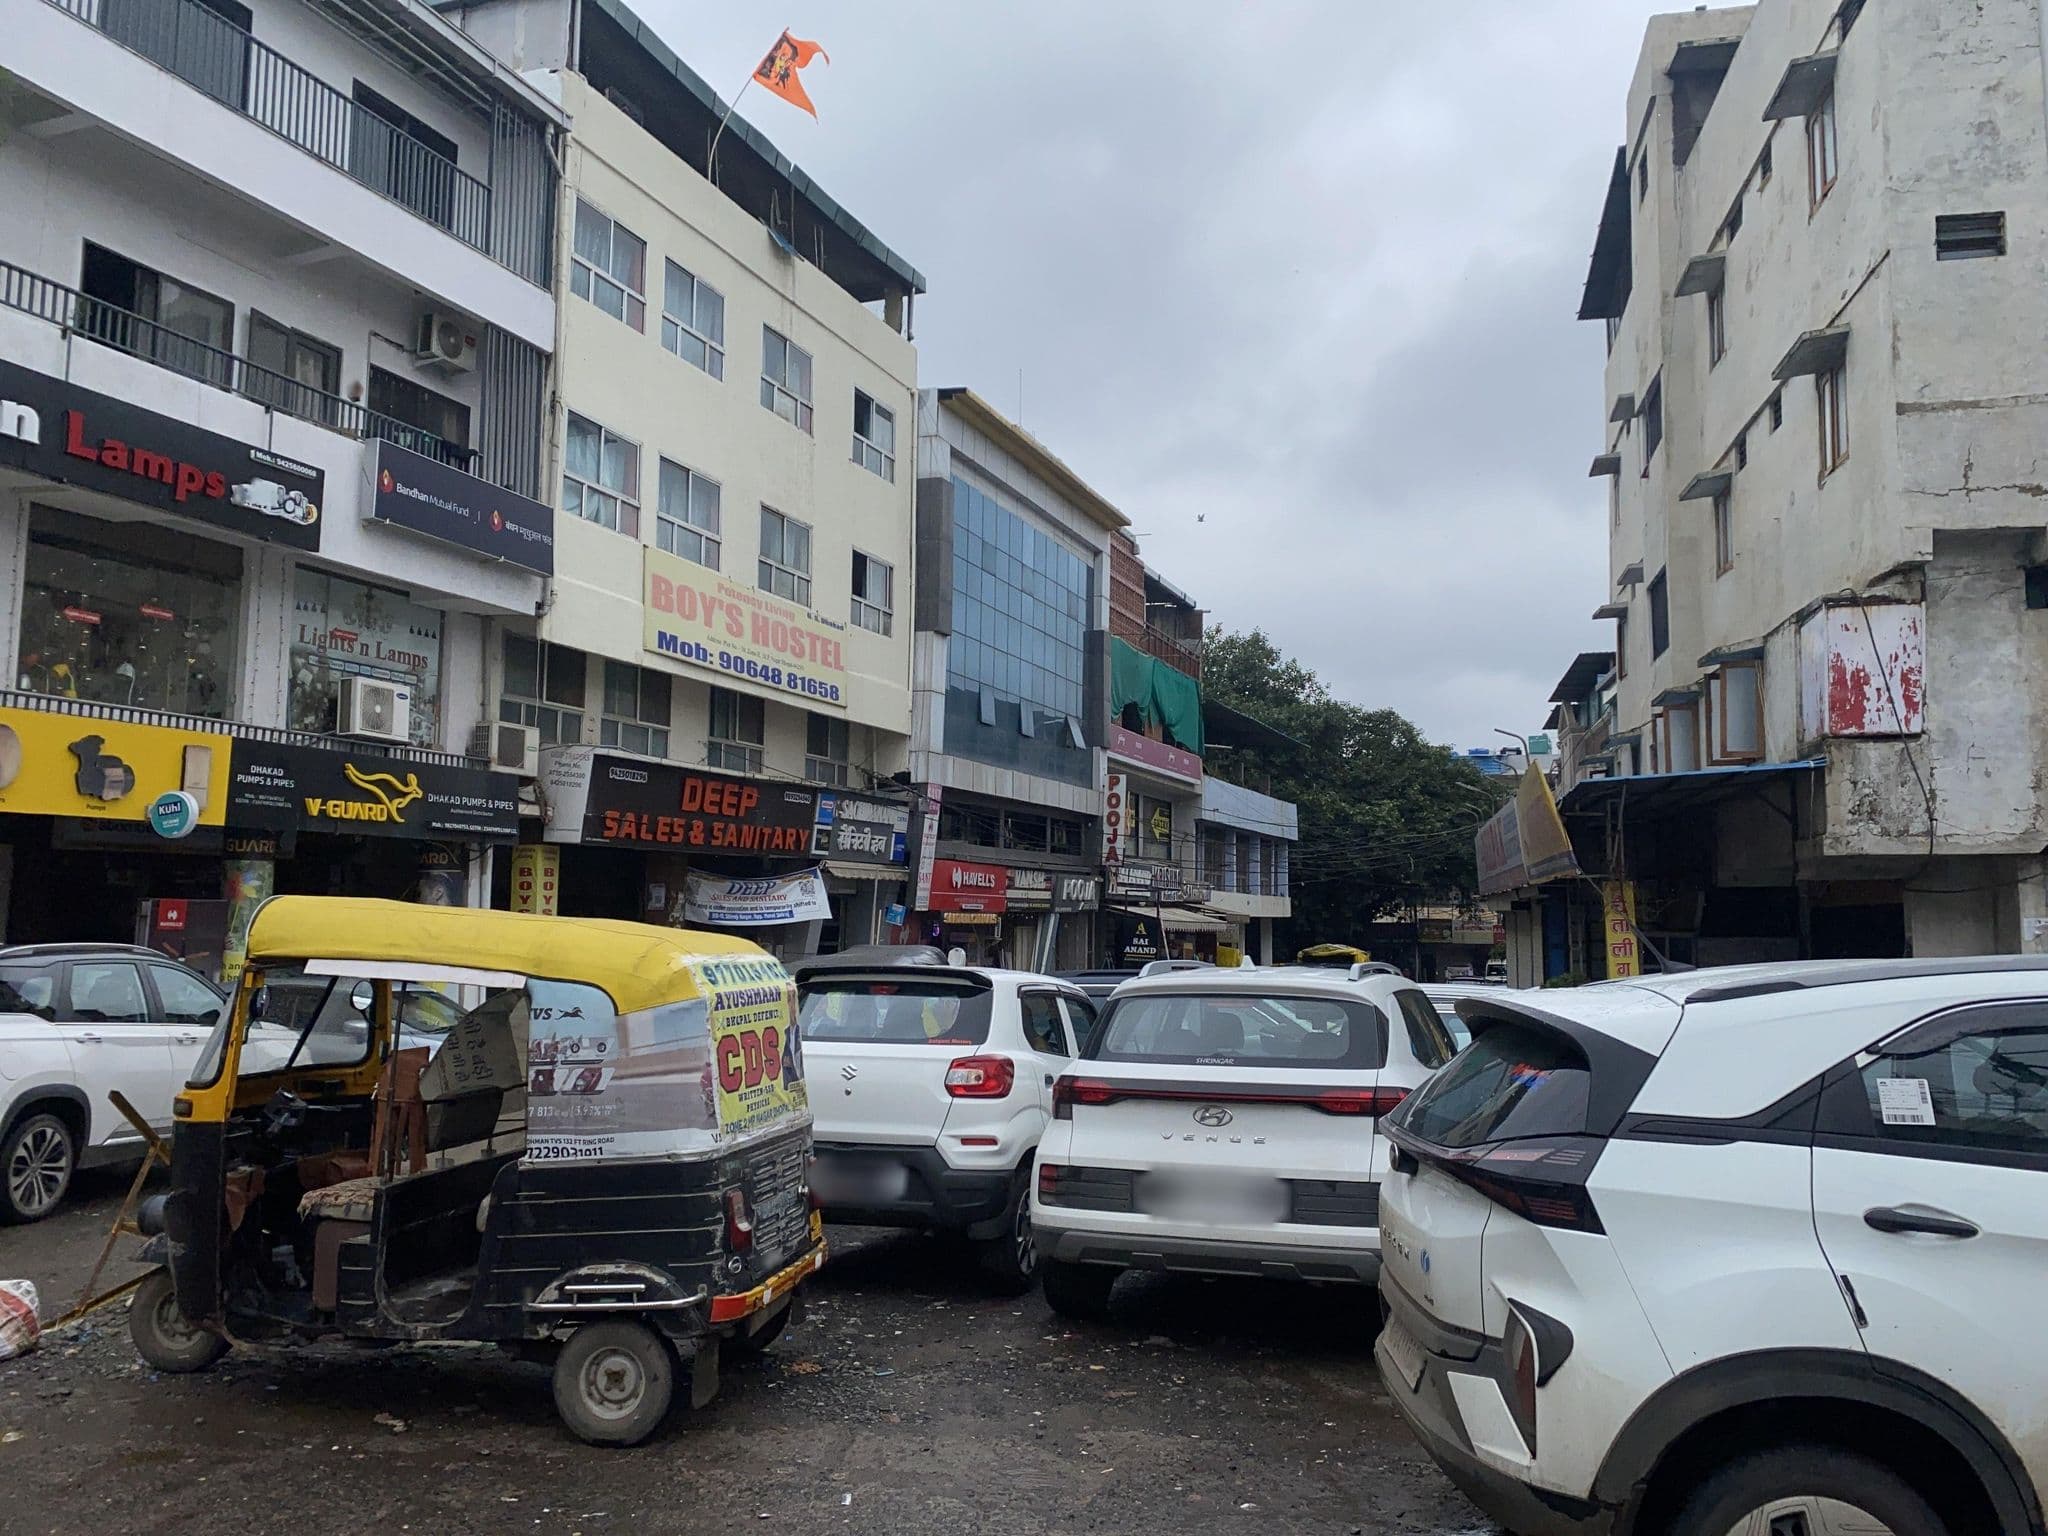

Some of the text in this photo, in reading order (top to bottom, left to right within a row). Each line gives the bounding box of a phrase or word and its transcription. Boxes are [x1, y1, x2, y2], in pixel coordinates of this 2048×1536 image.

[66, 409, 225, 501] Lamps
[396, 483, 469, 517] Bandhan Mutual Fund
[651, 573, 745, 639] BOY'S
[751, 611, 845, 672] HOSTEL
[299, 623, 355, 654] Lights
[360, 642, 369, 657] n
[375, 641, 428, 671] Lamps
[657, 630, 714, 665] Mob:
[718, 651, 782, 685] 90648
[787, 673, 840, 701] 81658
[250, 765, 284, 777] DHAKAD
[609, 766, 648, 782] 9425018296
[237, 774, 295, 788] PUMPS & PIPES
[428, 793, 514, 811] DHAKAD PUMPS & PIPES
[681, 776, 759, 818] DEEP
[304, 798, 388, 823] V-GUARD
[1105, 775, 1121, 862] POOJA
[602, 809, 810, 851] SALES & SANITARY
[726, 881, 777, 896] DEEP
[749, 894, 787, 902] SANITARY
[1062, 879, 1096, 900] POOJA
[1124, 946, 1157, 954] ANAND
[714, 985, 781, 1011] AYUSHMAAN
[726, 1013, 752, 1027] BHOPAL
[716, 1026, 781, 1093] CDS
[1195, 1057, 1235, 1065] SHRINGAR
[725, 1120, 743, 1135] ZONE
[582, 1138, 597, 1146] RING
[597, 1137, 615, 1145] ROAD
[1159, 1131, 1266, 1146] VENUE
